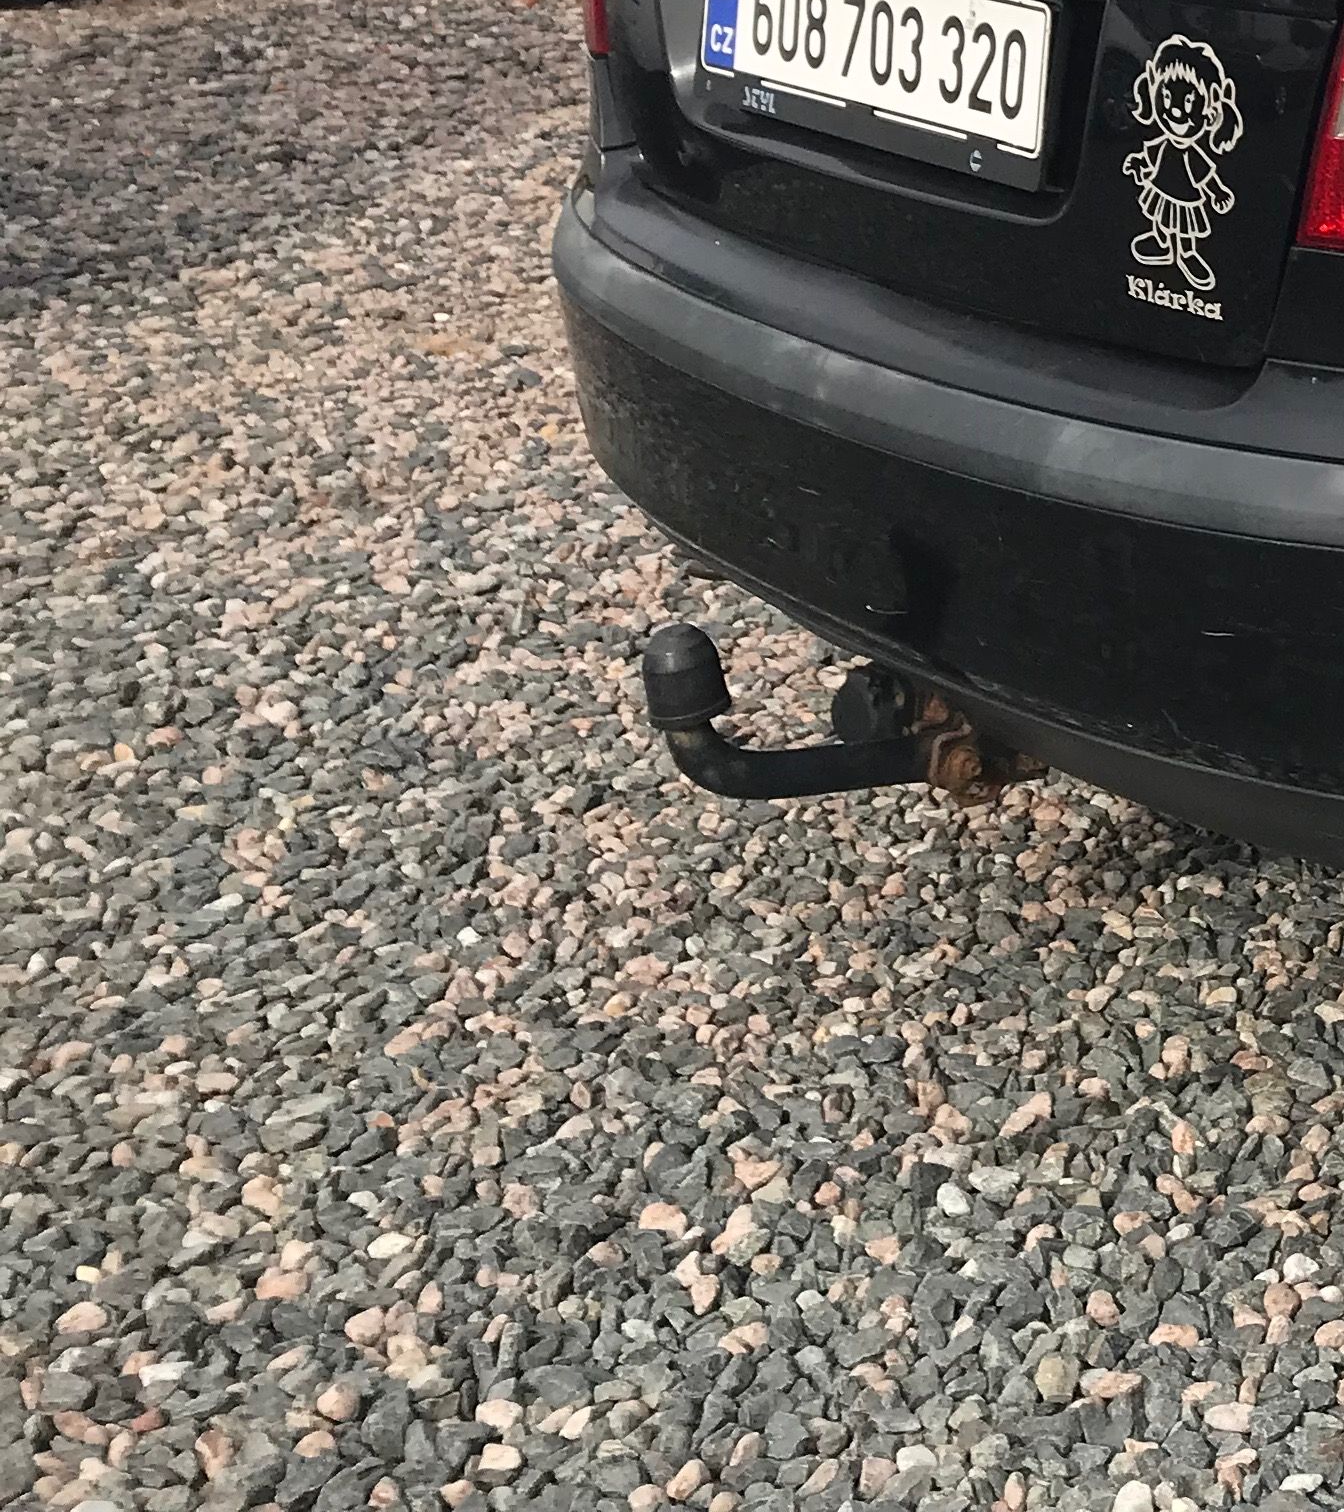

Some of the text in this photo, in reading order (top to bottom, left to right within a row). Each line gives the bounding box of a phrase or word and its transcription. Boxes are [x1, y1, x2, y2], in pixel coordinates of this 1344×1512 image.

[710, 23, 734, 55] CZ
[939, 15, 1027, 120] 320
[1126, 274, 1224, 321] Klárka
